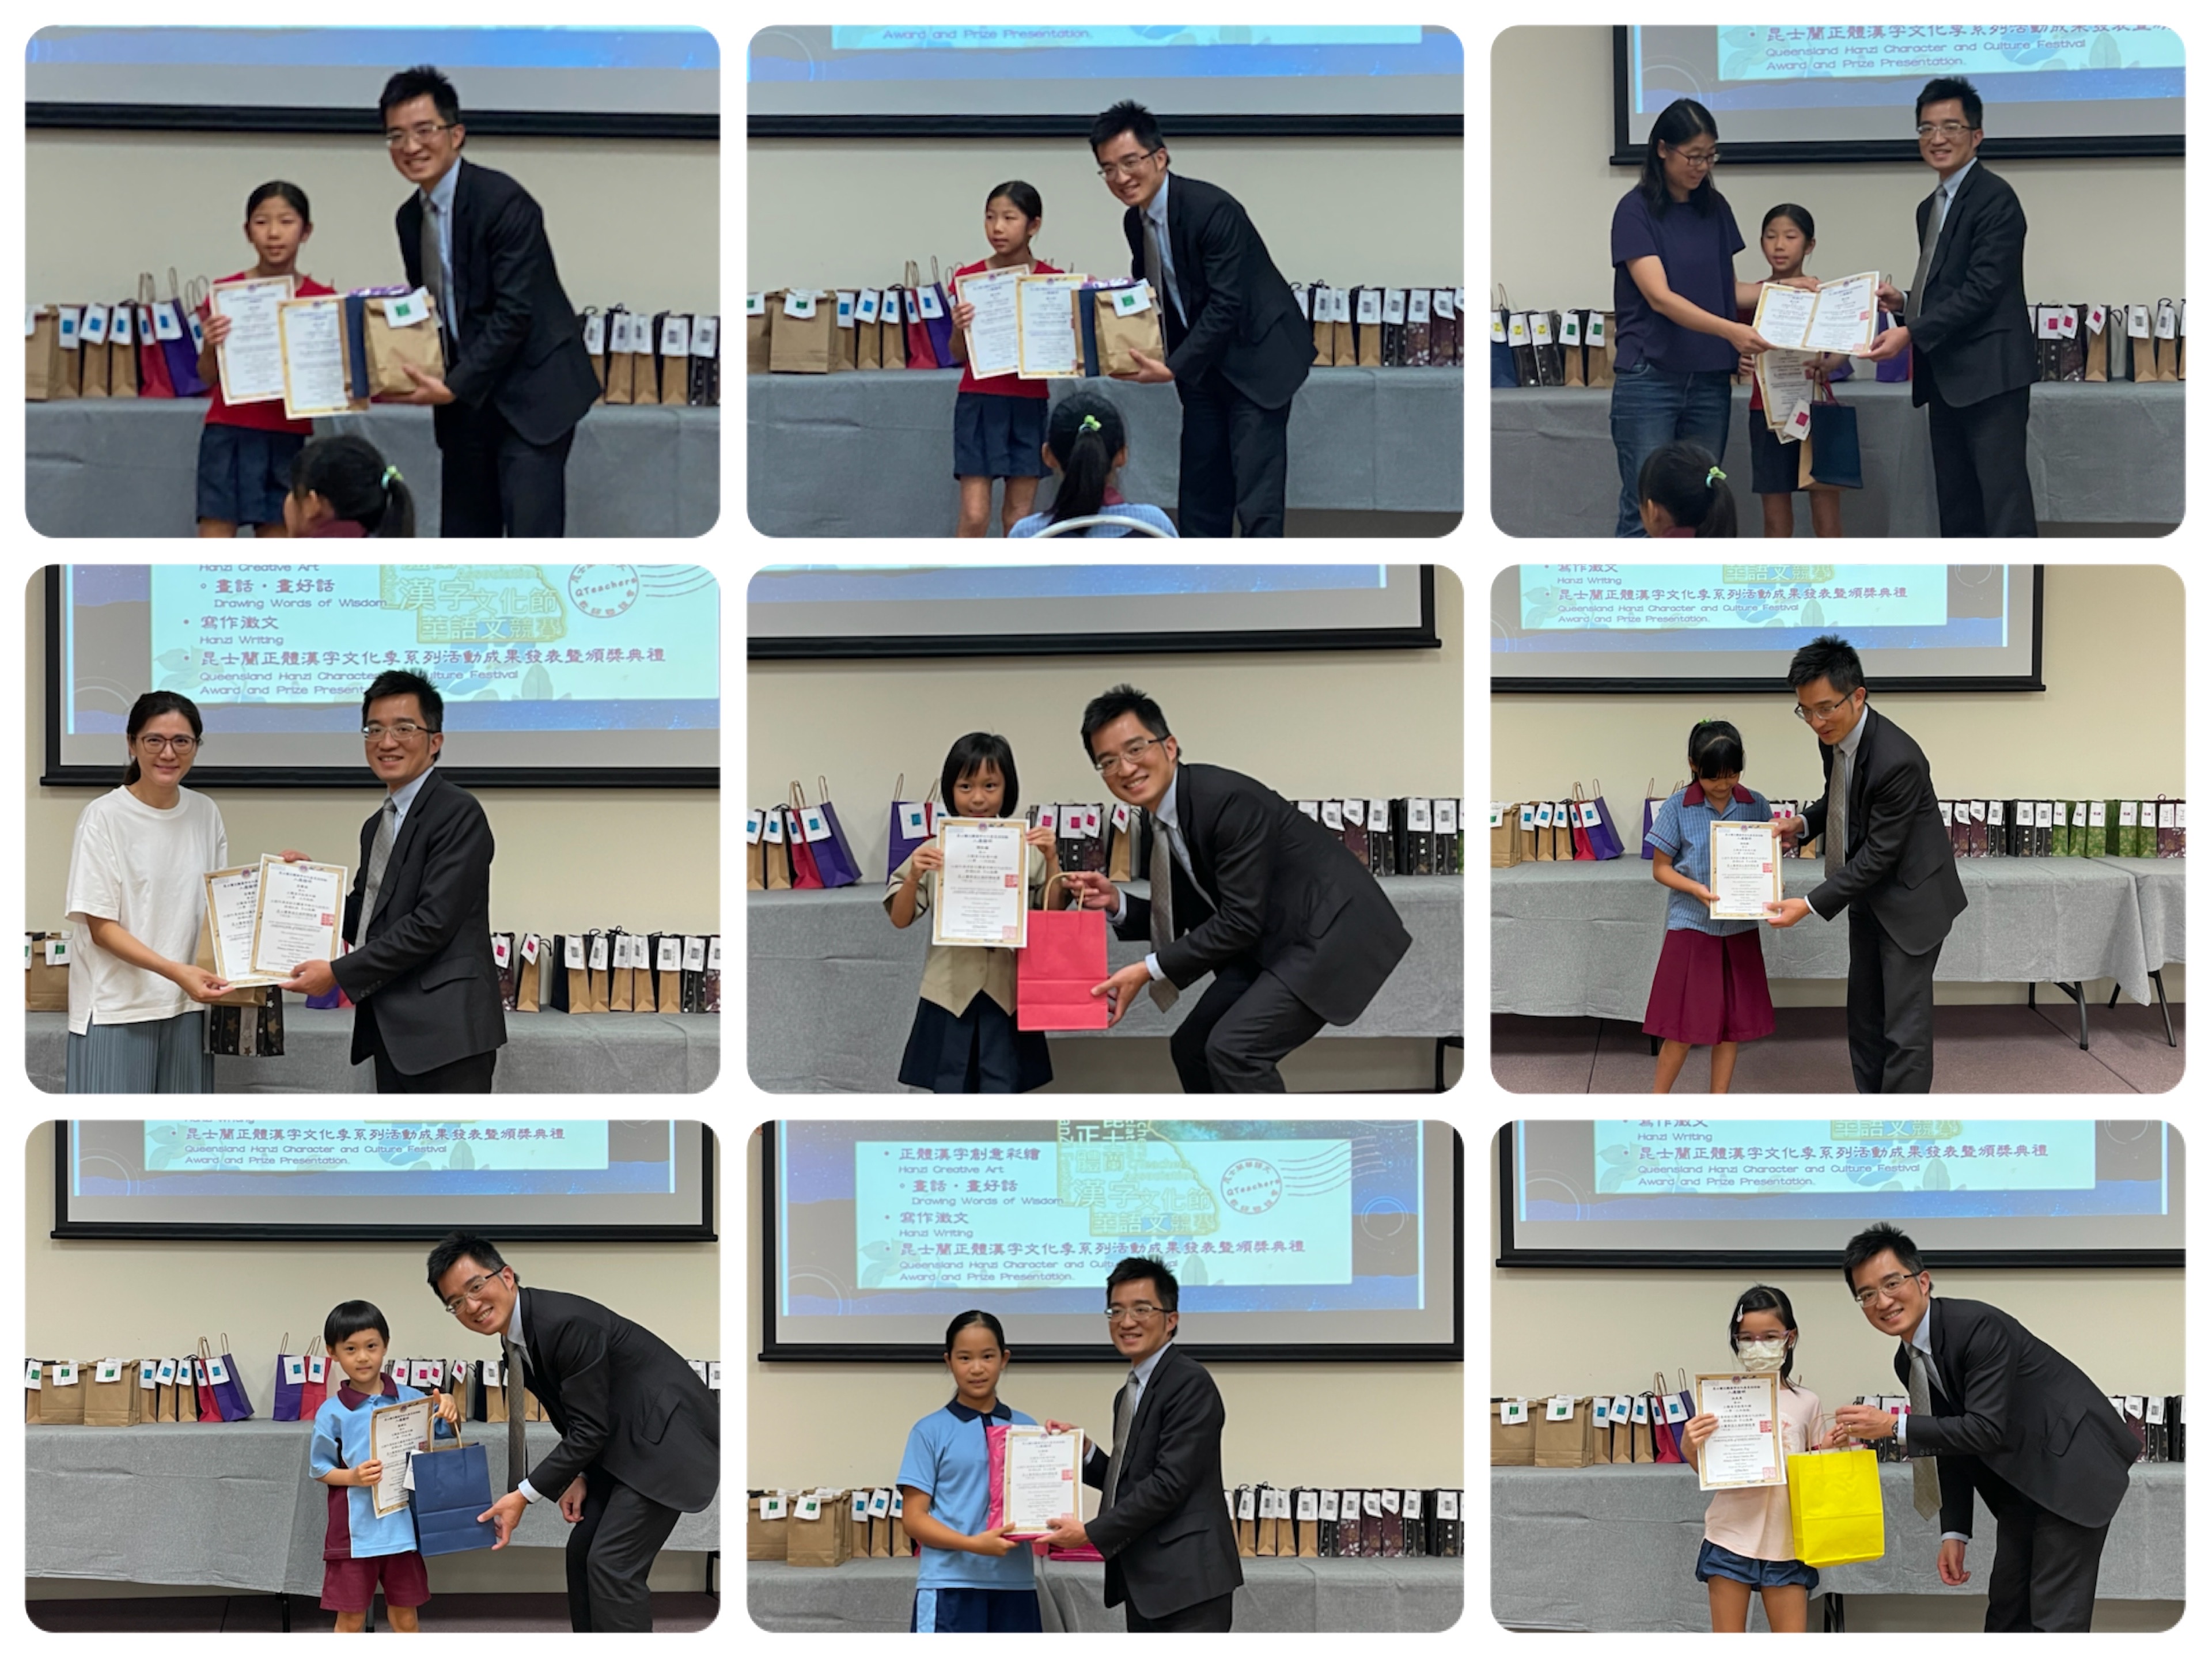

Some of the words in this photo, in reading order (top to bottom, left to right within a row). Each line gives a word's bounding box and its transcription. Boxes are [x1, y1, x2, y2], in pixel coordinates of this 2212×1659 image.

[884, 29, 926, 39] Award
[933, 30, 956, 39] and
[964, 29, 997, 39] Prize
[1766, 46, 1838, 57] Queensland
[1845, 46, 1878, 54] Hanzi
[1884, 44, 1946, 53] Character
[1954, 43, 1976, 51] and
[1984, 41, 2030, 51] Culture
[2037, 39, 2085, 48] Festival
[1767, 62, 1806, 70] Award
[1814, 60, 1835, 69] and
[1843, 59, 1874, 67] Prize
[1588, 577, 1622, 585] Writing
[214, 599, 264, 609] Drawing
[271, 599, 312, 607] Words
[319, 599, 332, 607] of
[339, 599, 387, 607] Wisdom
[200, 636, 232, 645] Hanzi
[239, 636, 283, 646] Writing
[200, 672, 272, 681] Queensland
[279, 672, 312, 680] Hanzi
[430, 671, 464, 680] ulture
[471, 670, 518, 679] Festival
[200, 686, 241, 695] Award
[247, 686, 268, 695] and
[276, 686, 308, 695] Prize
[1673, 1133, 1713, 1142] Writing
[365, 1145, 402, 1153] Culture
[1638, 1165, 1703, 1173] Queensland
[1805, 1165, 1825, 1173] and
[1831, 1164, 1872, 1172] Culture
[1878, 1164, 1920, 1172] Festival
[1638, 1177, 1675, 1185] Award
[1680, 1177, 1700, 1185] and
[1707, 1177, 1734, 1185] Prize
[912, 1197, 956, 1206] Drawing
[933, 1229, 974, 1238] Writing
[900, 1261, 963, 1269] Queensland
[1003, 1260, 1058, 1268] Character
[1064, 1260, 1084, 1268] and
